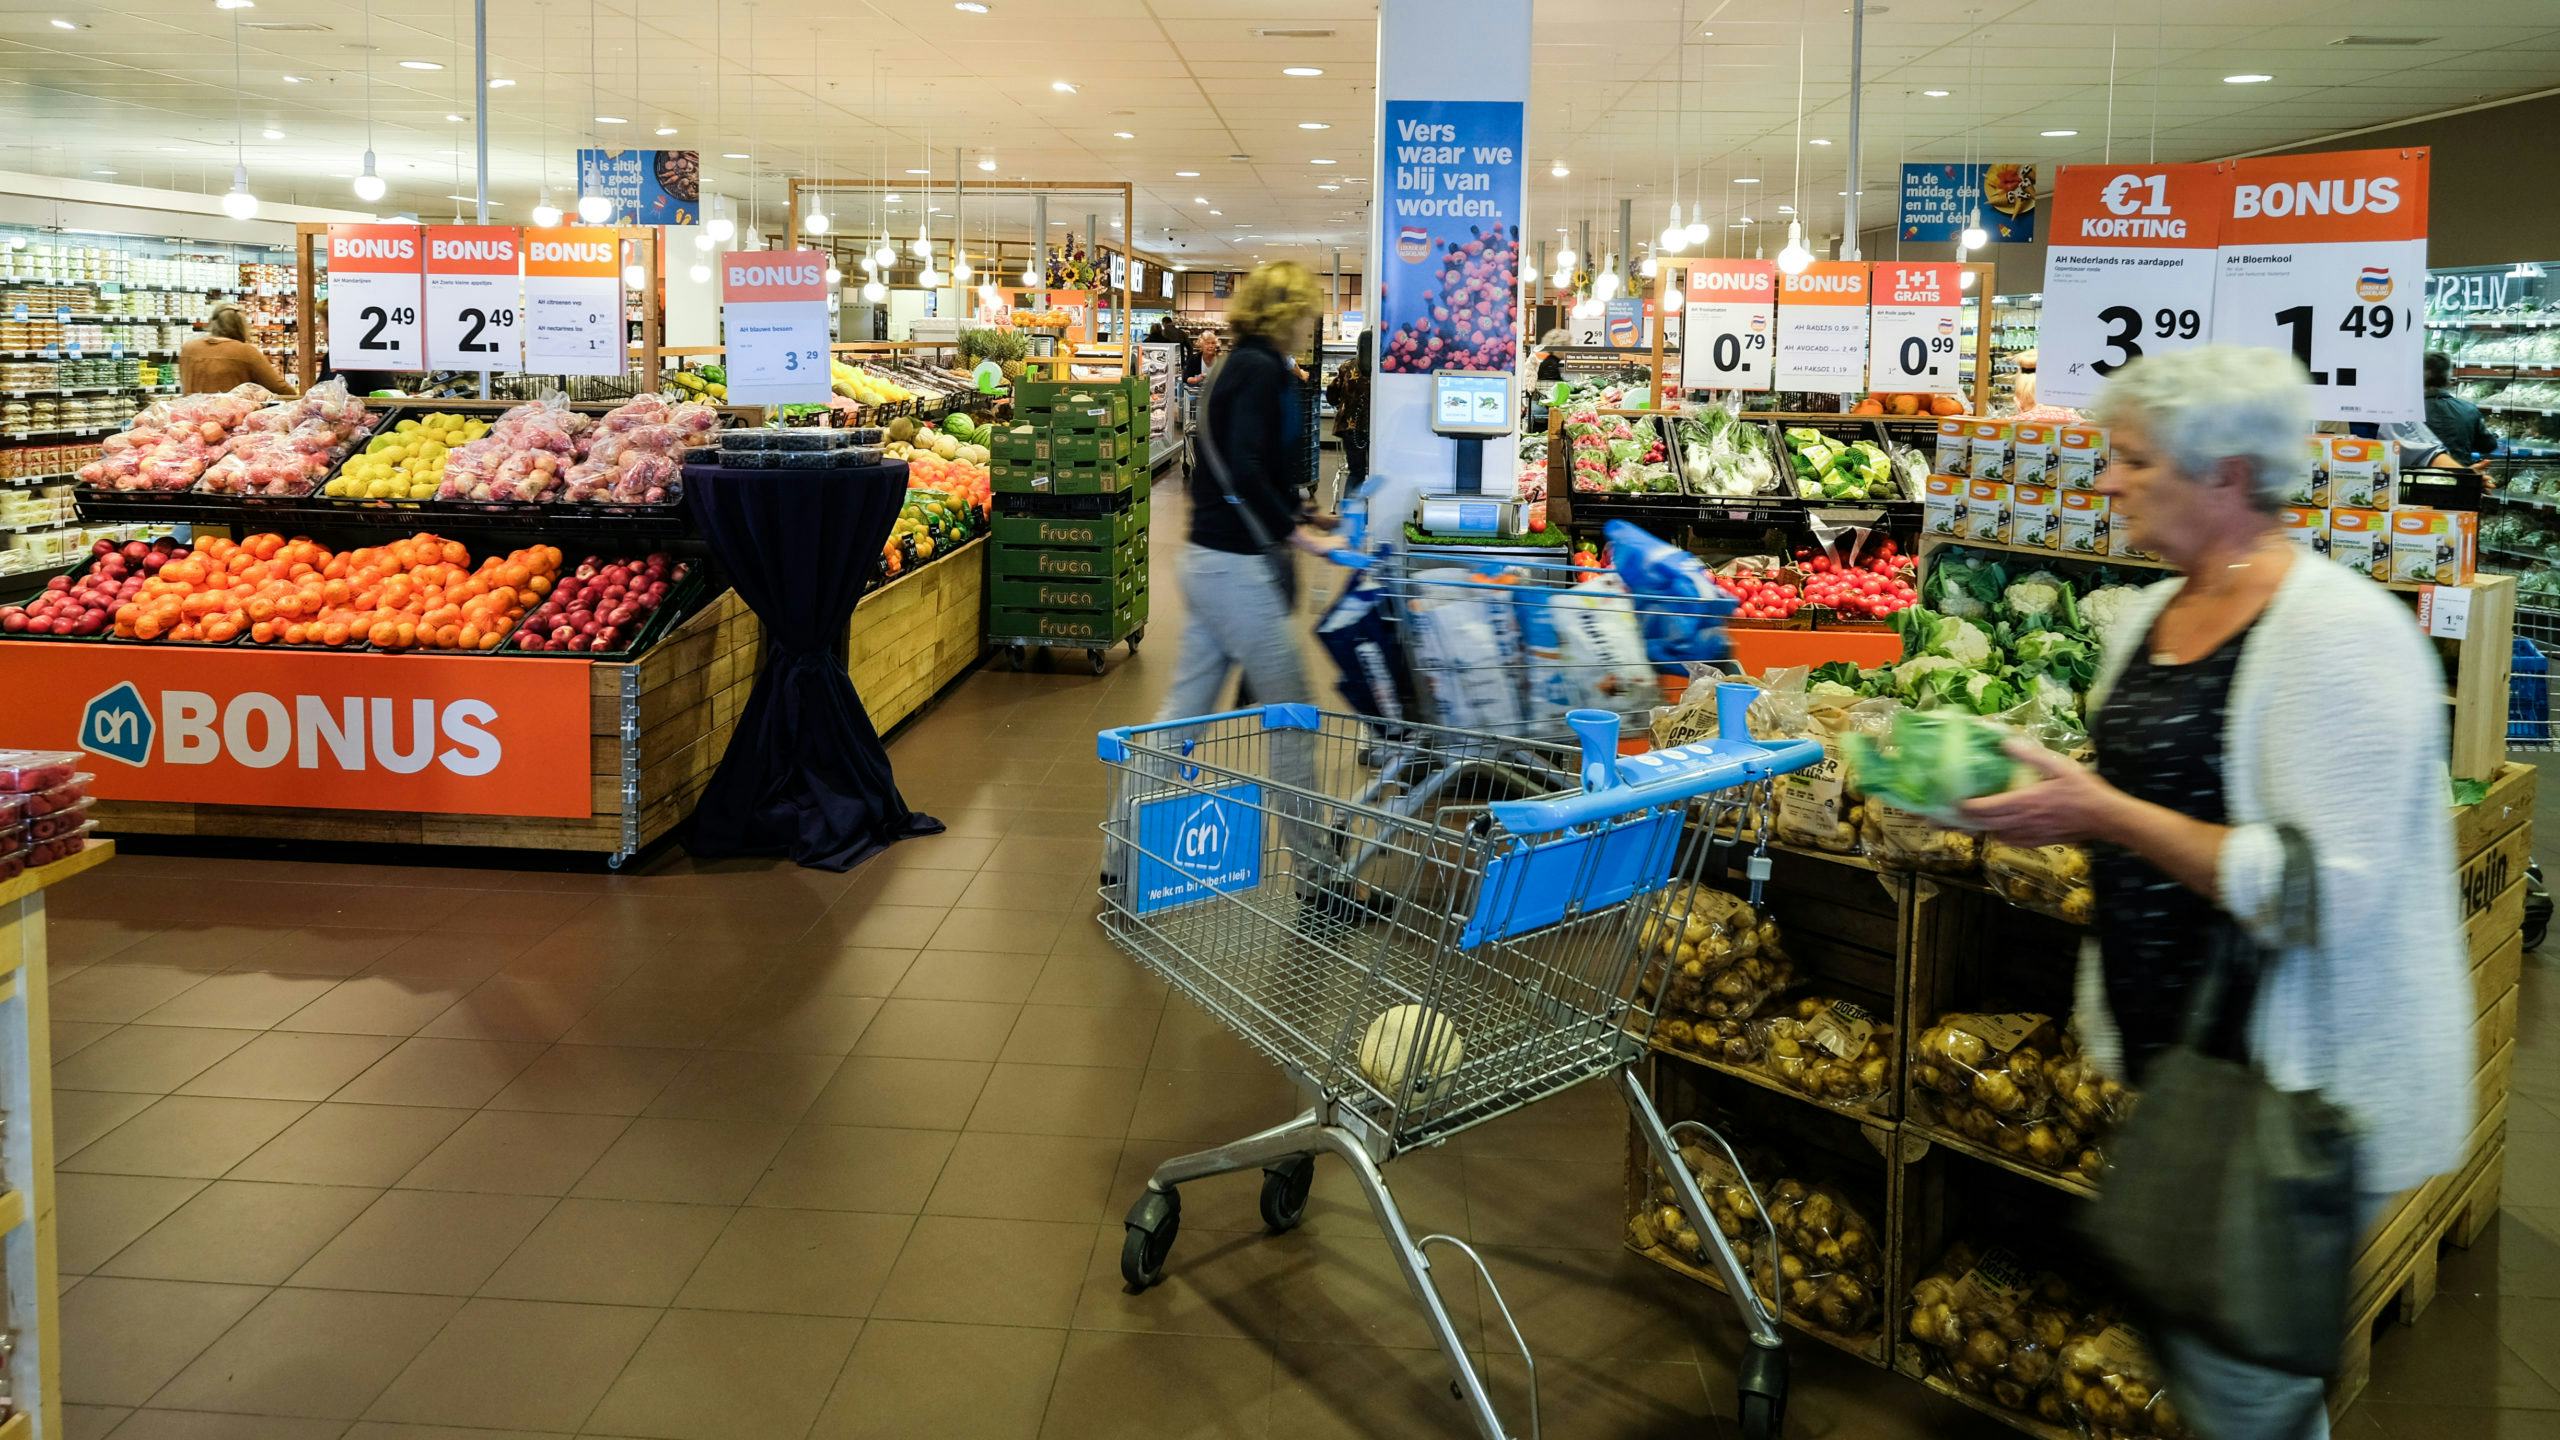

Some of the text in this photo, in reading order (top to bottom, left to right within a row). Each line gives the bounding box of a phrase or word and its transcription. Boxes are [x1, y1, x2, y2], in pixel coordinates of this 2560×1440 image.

[1397, 119, 1456, 142] Vers
[1397, 146, 1513, 165] waar we
[600, 160, 609, 171] is
[613, 160, 642, 173] altijd
[608, 173, 643, 186] goede
[1397, 166, 1490, 195] blij van
[1906, 173, 1938, 184] In de
[621, 187, 639, 196] om
[1906, 185, 1980, 200] middag één
[2100, 173, 2172, 216] €1
[2233, 176, 2400, 219] BONUS
[1396, 193, 1502, 217] worden.
[1905, 199, 1956, 211] en in de
[1905, 212, 1943, 224] avond
[2081, 219, 2187, 239] KORTING
[333, 238, 414, 259] BONUS
[432, 240, 513, 261] BONUS
[530, 241, 613, 262] BONUS
[2070, 256, 2119, 265] Nederlands
[2138, 258, 2184, 267] aardappel
[2242, 254, 2292, 264] Bloemkool
[729, 265, 820, 287] BONUS
[1692, 272, 1769, 291] BONUS
[1785, 274, 1862, 293] BONUS
[1895, 269, 1940, 290] 1+1
[1894, 290, 1940, 302] GRATIS
[2419, 592, 2431, 627] BONUS
[161, 690, 502, 776] BONUS
